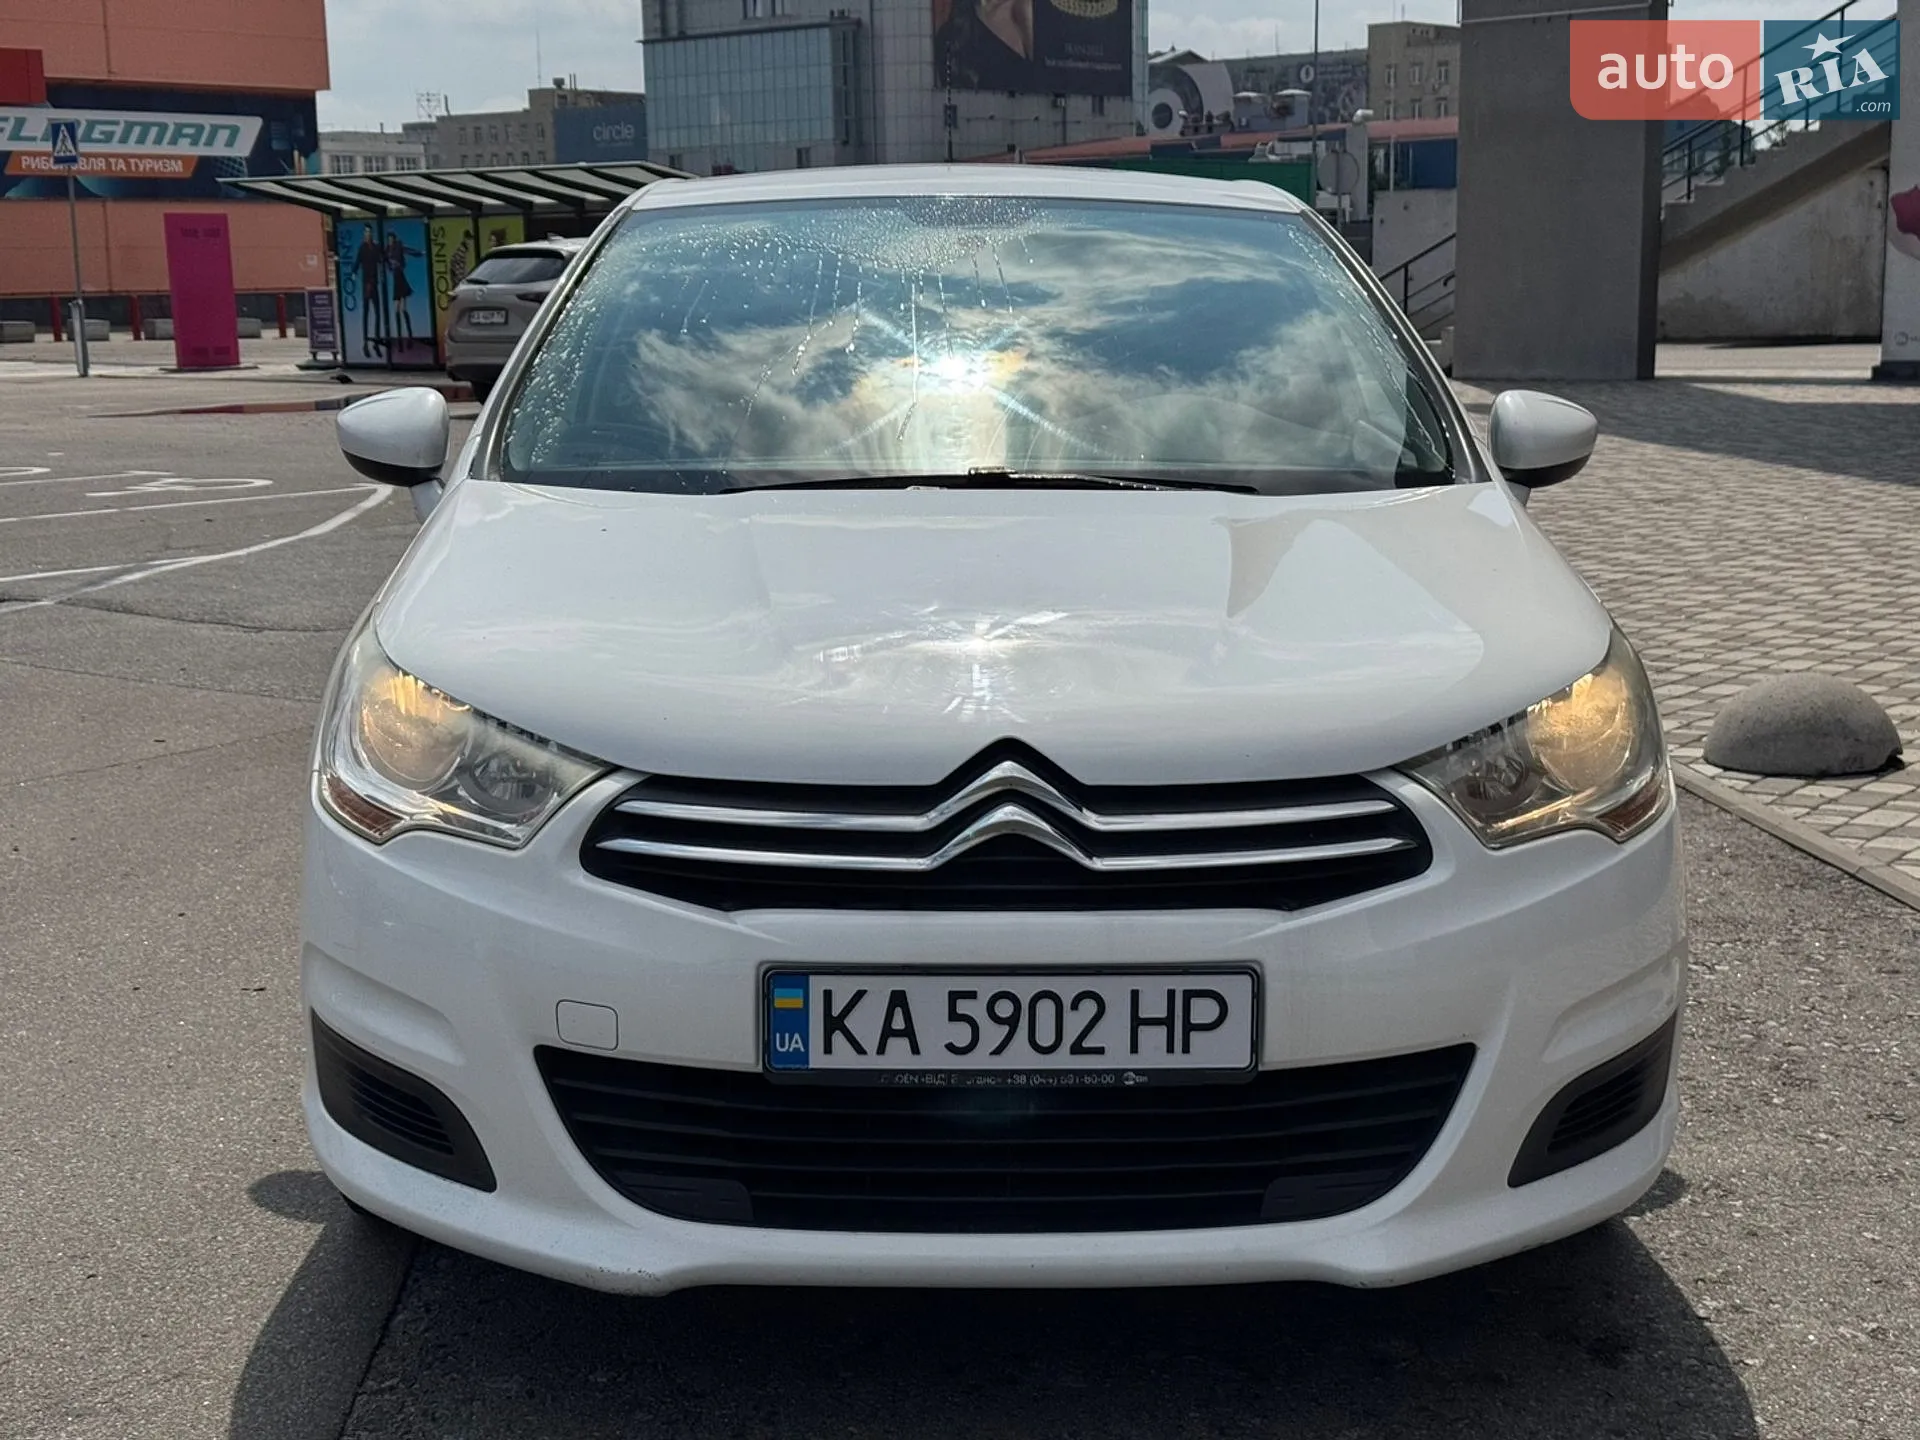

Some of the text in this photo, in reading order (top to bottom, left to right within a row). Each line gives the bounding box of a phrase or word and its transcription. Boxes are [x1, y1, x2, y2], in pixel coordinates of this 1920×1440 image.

[592, 120, 635, 142] circle
[108, 157, 127, 171] ТА
[128, 158, 184, 173] ТУРИЗМ
[431, 225, 449, 312] COLIN'S
[822, 988, 1229, 1056] KA 5902 HP
[775, 1033, 805, 1052] UA
